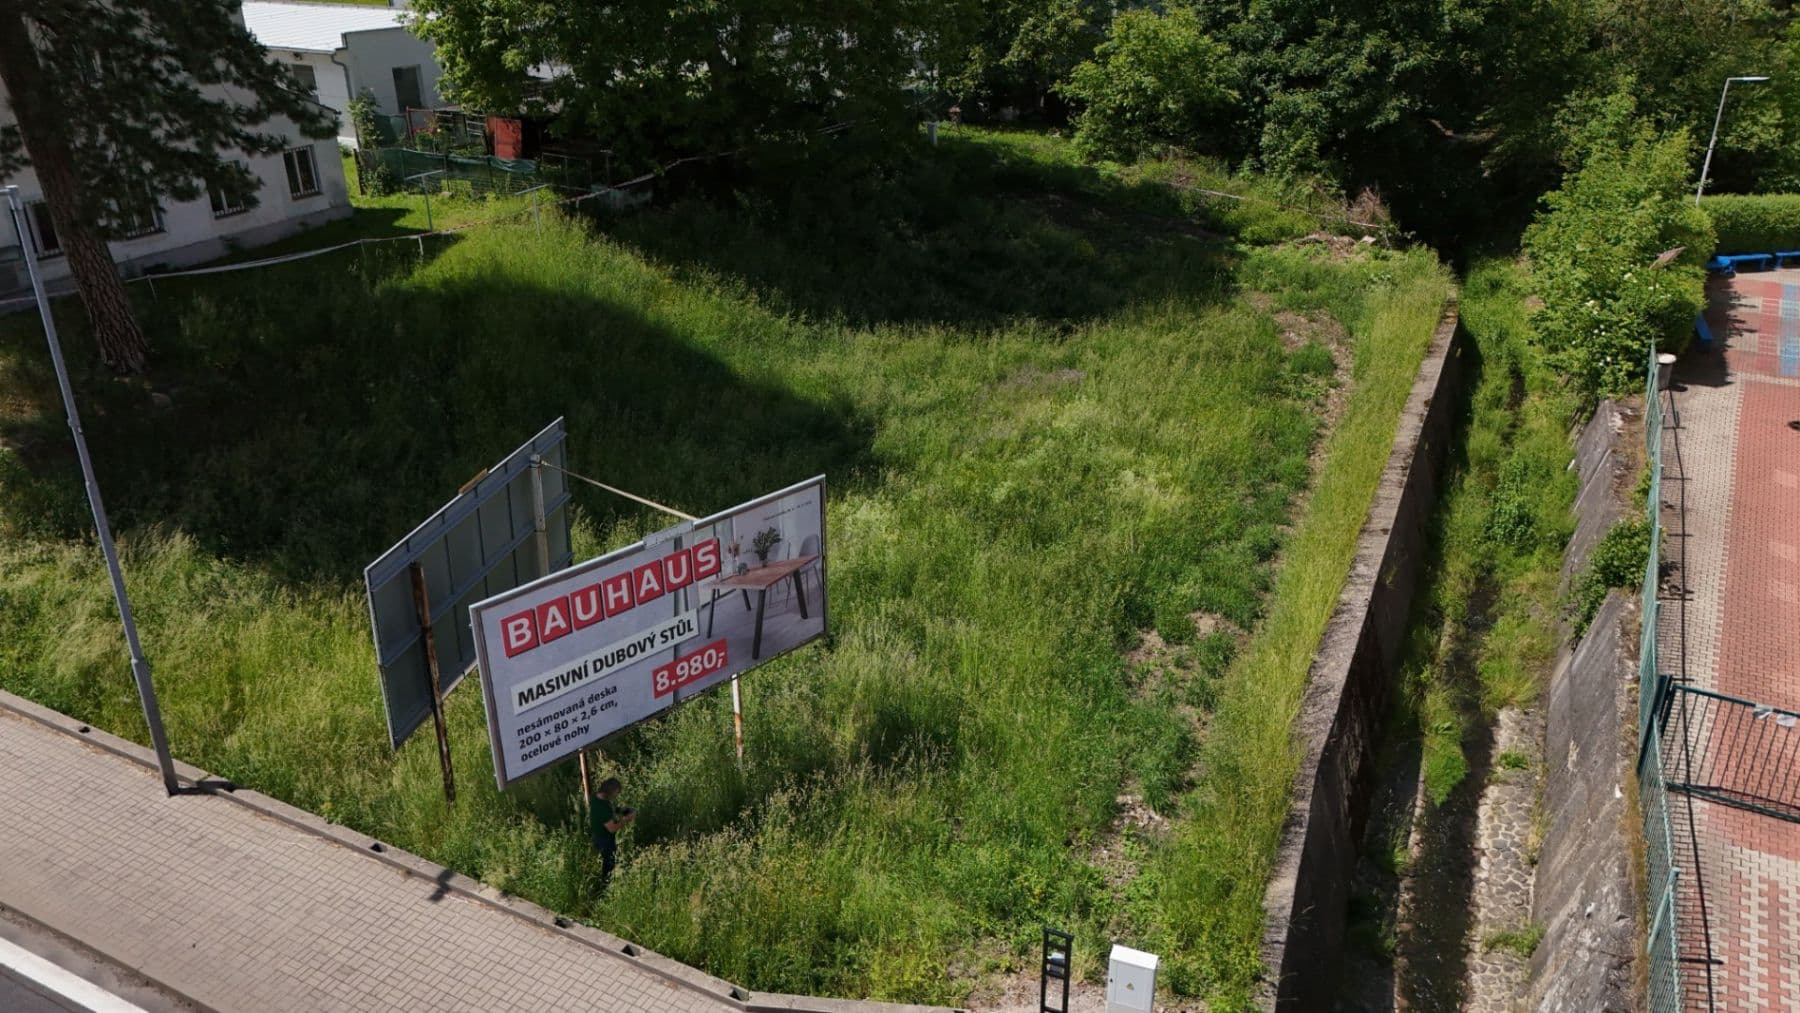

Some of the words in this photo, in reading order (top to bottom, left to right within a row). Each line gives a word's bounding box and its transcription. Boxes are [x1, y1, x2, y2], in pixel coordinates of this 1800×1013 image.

[508, 545, 716, 649] BAUHAUS
[518, 662, 589, 707] MASIVNÍ
[593, 635, 657, 674] DUBOVÝ
[660, 619, 694, 645] STŮL
[517, 700, 585, 736] nesámovaná
[587, 685, 617, 704] deska
[519, 733, 541, 749] 200
[554, 720, 569, 733] 80
[581, 706, 597, 721] 2,6
[600, 700, 618, 712] cm,
[520, 738, 562, 762] ocelové
[564, 724, 590, 742] nohy
